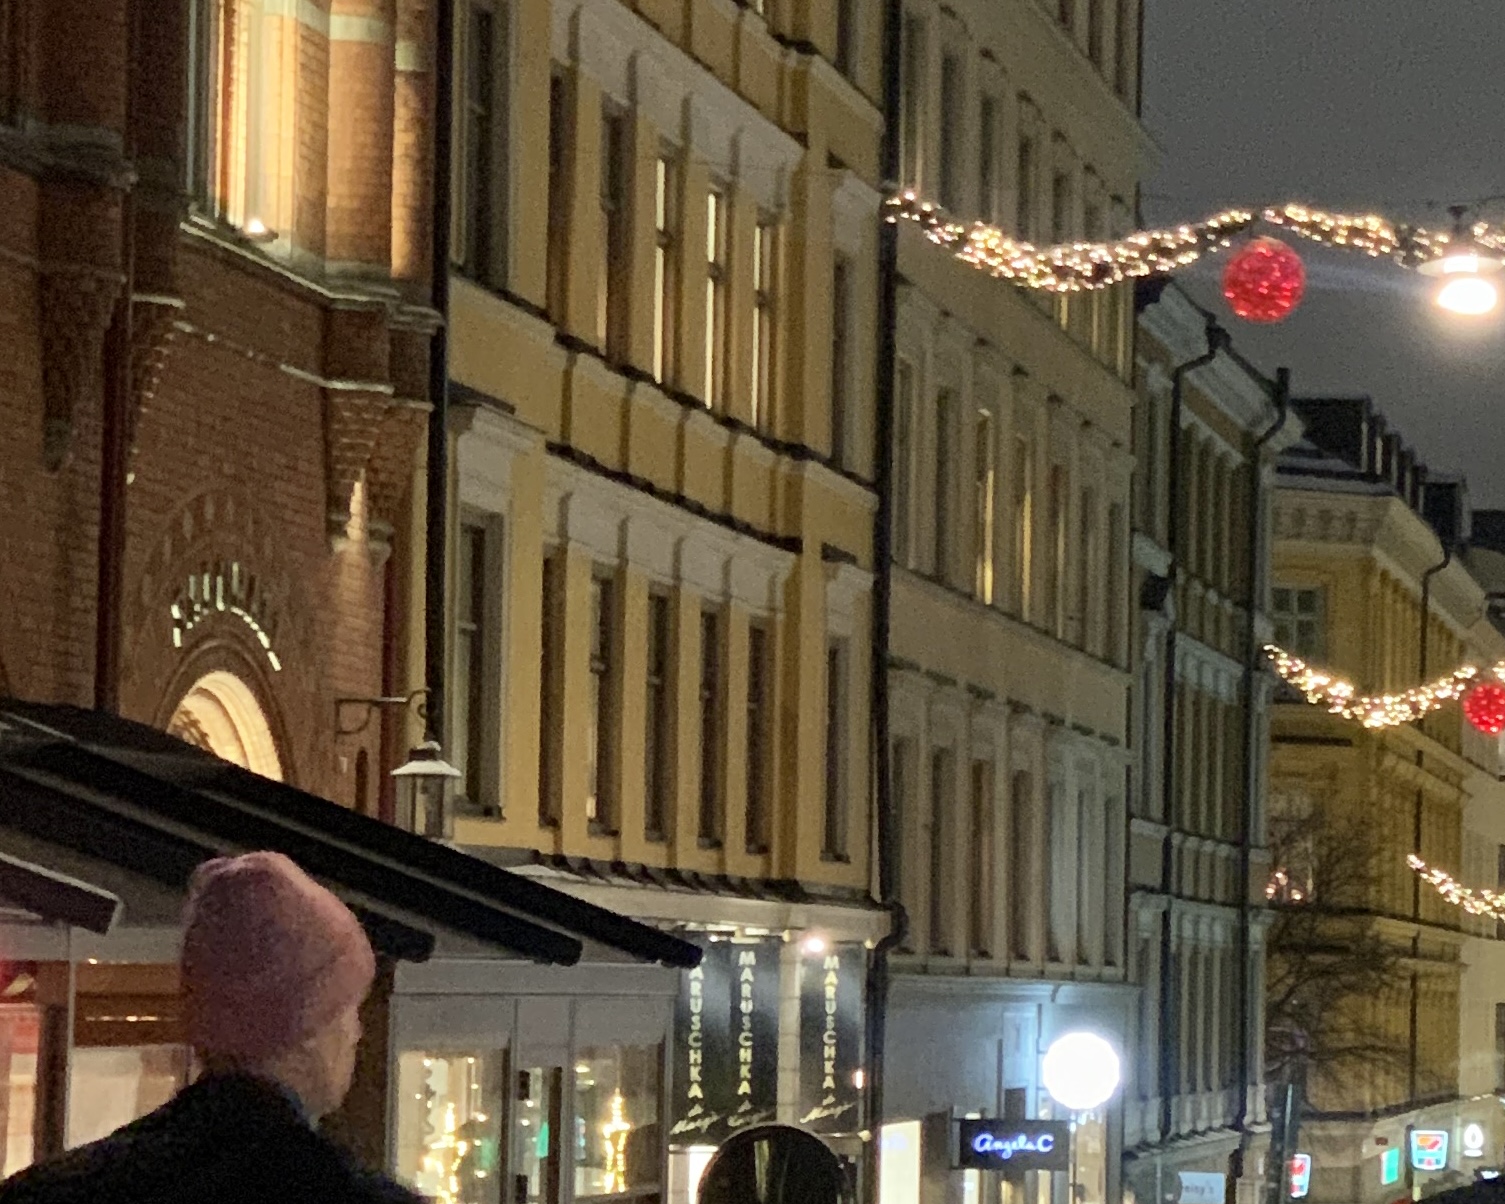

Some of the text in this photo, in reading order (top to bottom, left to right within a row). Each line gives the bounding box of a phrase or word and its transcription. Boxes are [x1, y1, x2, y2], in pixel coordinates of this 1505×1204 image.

[687, 956, 707, 1099] ARUSCHKA
[738, 951, 756, 1095] MARUSCHKA
[822, 955, 839, 1089] MARUSCHKA
